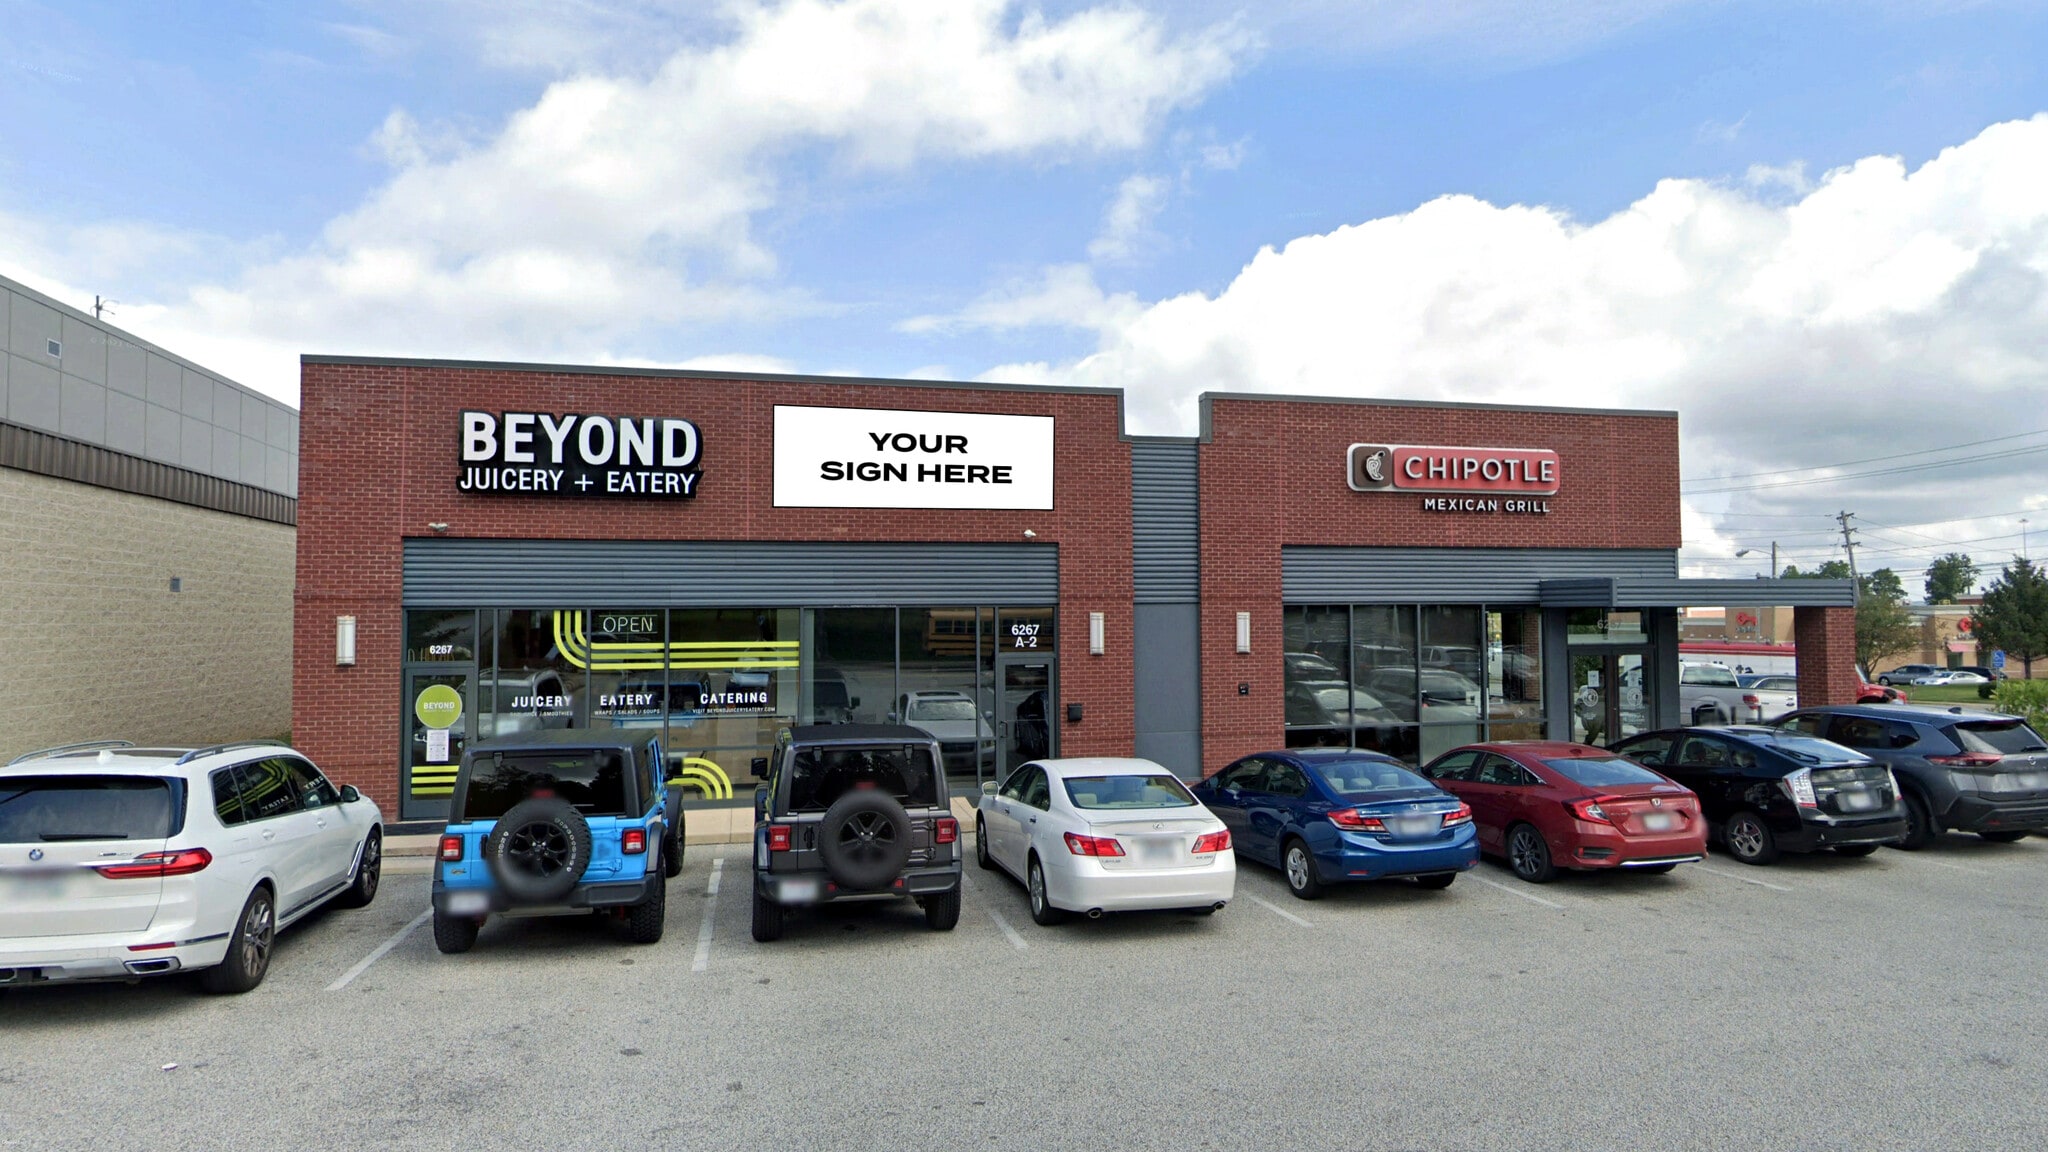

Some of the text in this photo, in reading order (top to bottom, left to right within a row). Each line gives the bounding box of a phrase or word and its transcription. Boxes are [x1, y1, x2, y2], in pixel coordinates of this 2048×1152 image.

[462, 411, 698, 468] BEYOND
[868, 432, 968, 454] YOUR
[820, 461, 1013, 484] SIGN HERE
[1404, 456, 1556, 483] CHIPOTLE
[460, 467, 696, 494] JUICERY + EATERY
[1424, 498, 1551, 513] MEXICAN GRILL
[603, 616, 653, 633] OPEN
[1011, 624, 1040, 635] 6267
[1015, 636, 1037, 647] A-2
[429, 645, 452, 654] 6267
[423, 701, 455, 710] BEYOND
[511, 695, 572, 708] JUICERY
[600, 694, 653, 706] EATERY
[700, 692, 768, 705] CATERING
